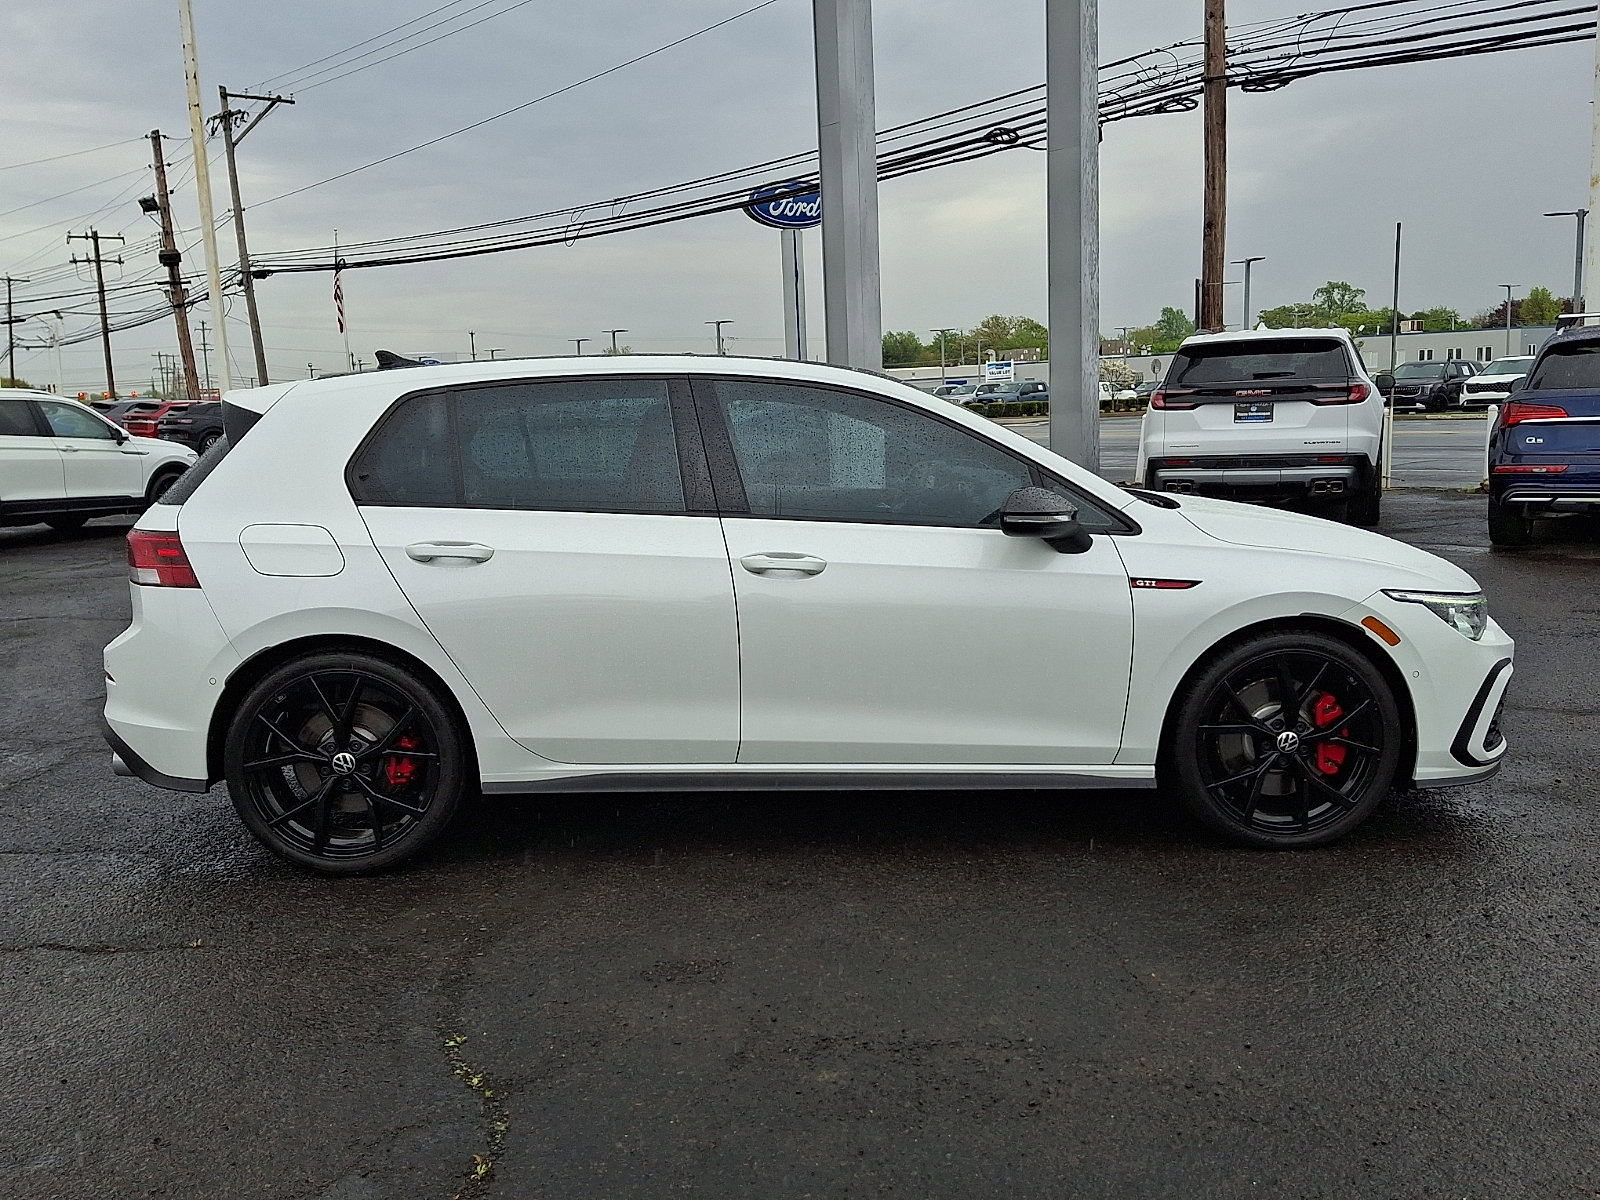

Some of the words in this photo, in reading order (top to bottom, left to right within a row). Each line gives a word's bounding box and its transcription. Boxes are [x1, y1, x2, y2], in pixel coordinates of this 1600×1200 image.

[769, 190, 821, 217] Ford
[1235, 389, 1271, 397] GMC
[1136, 579, 1156, 587] GTI
